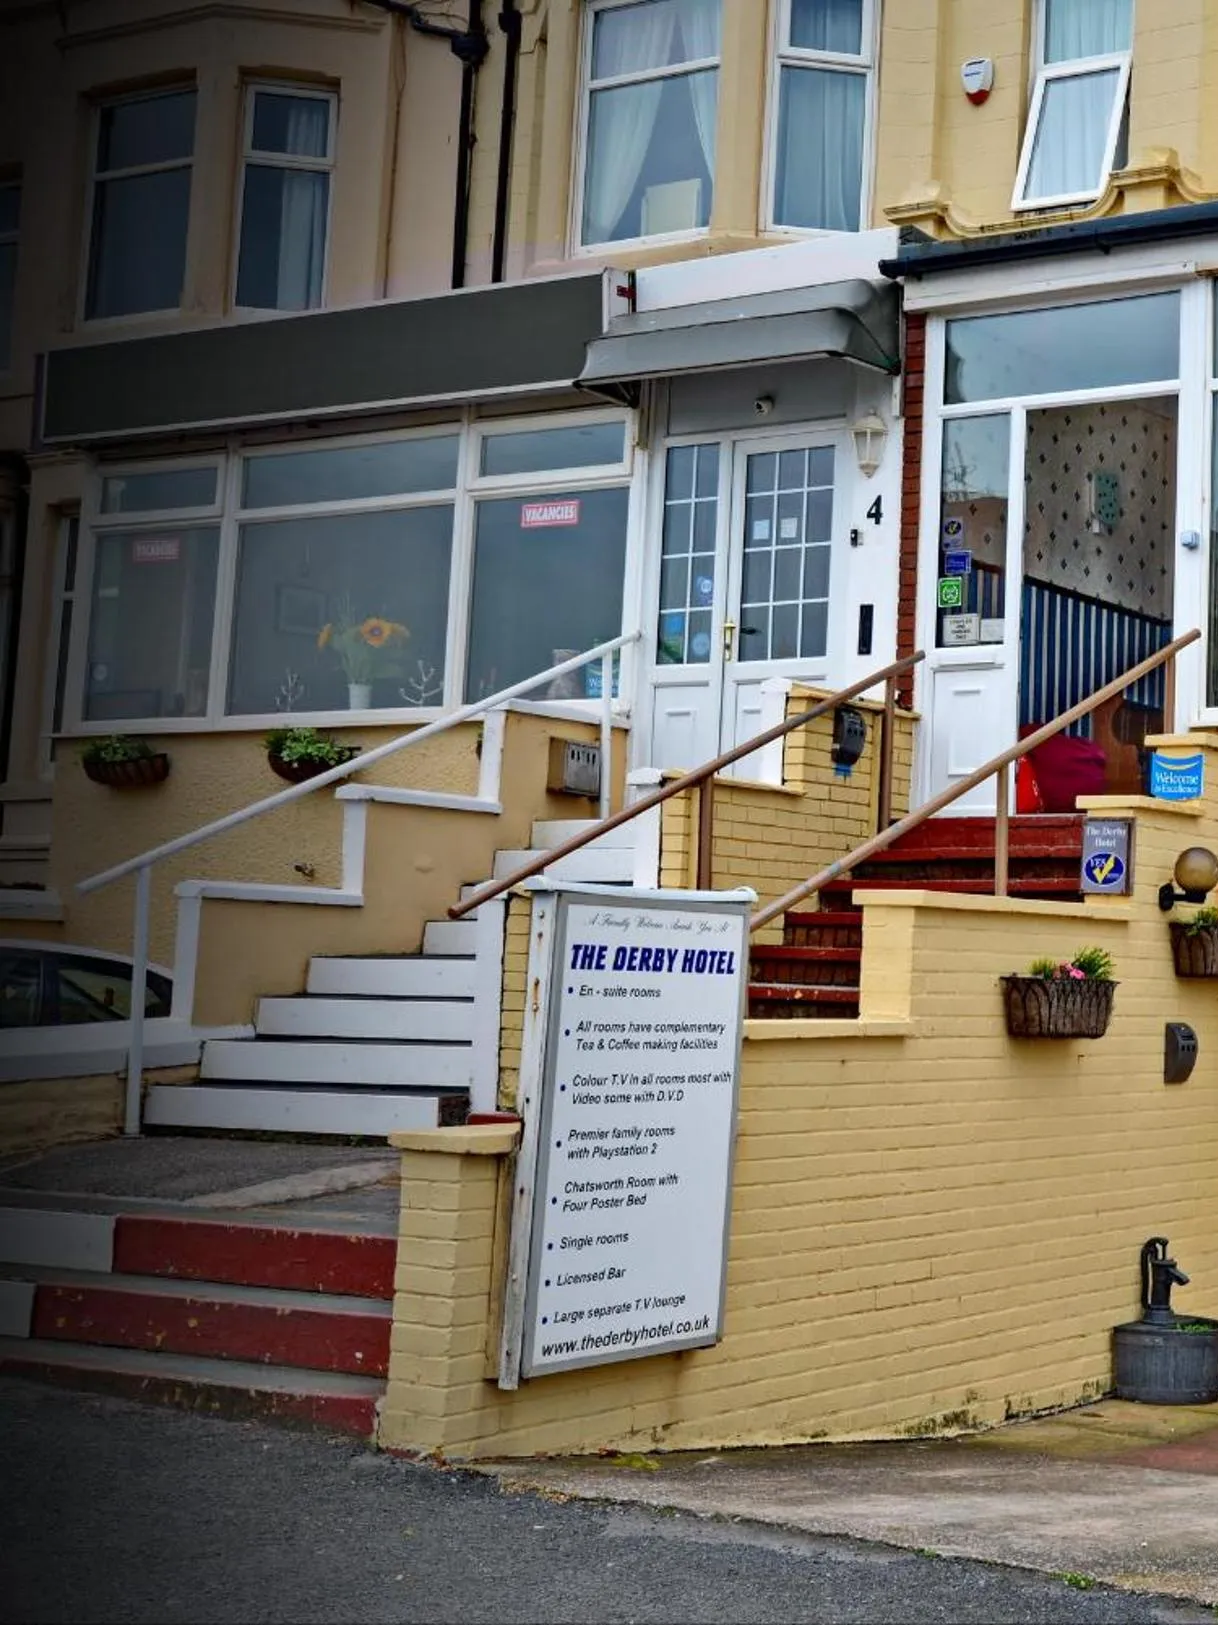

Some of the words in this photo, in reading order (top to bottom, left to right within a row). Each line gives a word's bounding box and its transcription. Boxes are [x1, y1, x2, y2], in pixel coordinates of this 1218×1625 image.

[525, 505, 575, 521] VACANCIES
[866, 494, 884, 525] 4
[1155, 772, 1199, 785] Welcome
[571, 944, 608, 970] THE
[612, 946, 678, 973] DERBY
[681, 949, 735, 974] HOTEL
[579, 985, 593, 997] En
[602, 985, 627, 998] suite
[629, 988, 661, 998] rooms
[576, 1020, 591, 1033] All
[593, 1023, 626, 1033] rooms
[628, 1021, 651, 1033] have
[654, 1021, 726, 1036] complementary
[576, 1038, 594, 1051] Tea
[597, 1038, 605, 1051] &
[608, 1038, 640, 1051] Coffee
[642, 1038, 677, 1052] making
[679, 1038, 718, 1050] facilities
[572, 1074, 608, 1088] Colour
[641, 1073, 653, 1085] all
[655, 1073, 686, 1085] rooms
[687, 1071, 712, 1084] most
[713, 1070, 731, 1083] with
[572, 1092, 600, 1105] Video
[604, 1094, 631, 1104] some
[634, 1091, 655, 1103] with
[568, 1128, 609, 1142] Premier
[611, 1126, 642, 1141] family
[644, 1125, 676, 1138] rooms
[567, 1147, 590, 1160] with
[592, 1144, 648, 1160] Playstation
[650, 1142, 658, 1155] 2
[564, 1177, 624, 1194] Chatsworth
[626, 1175, 656, 1189] Room
[658, 1172, 679, 1186] with
[563, 1199, 588, 1212] Four
[590, 1196, 624, 1210] Poster
[626, 1193, 647, 1207] Bed
[559, 1235, 593, 1250] Single
[595, 1231, 629, 1245] rooms
[556, 1268, 605, 1287] Licensed
[607, 1266, 627, 1280] Bar
[553, 1311, 585, 1325] Large
[587, 1304, 632, 1321] separate
[541, 1314, 710, 1357] www.thederbyhotel.co.uk
